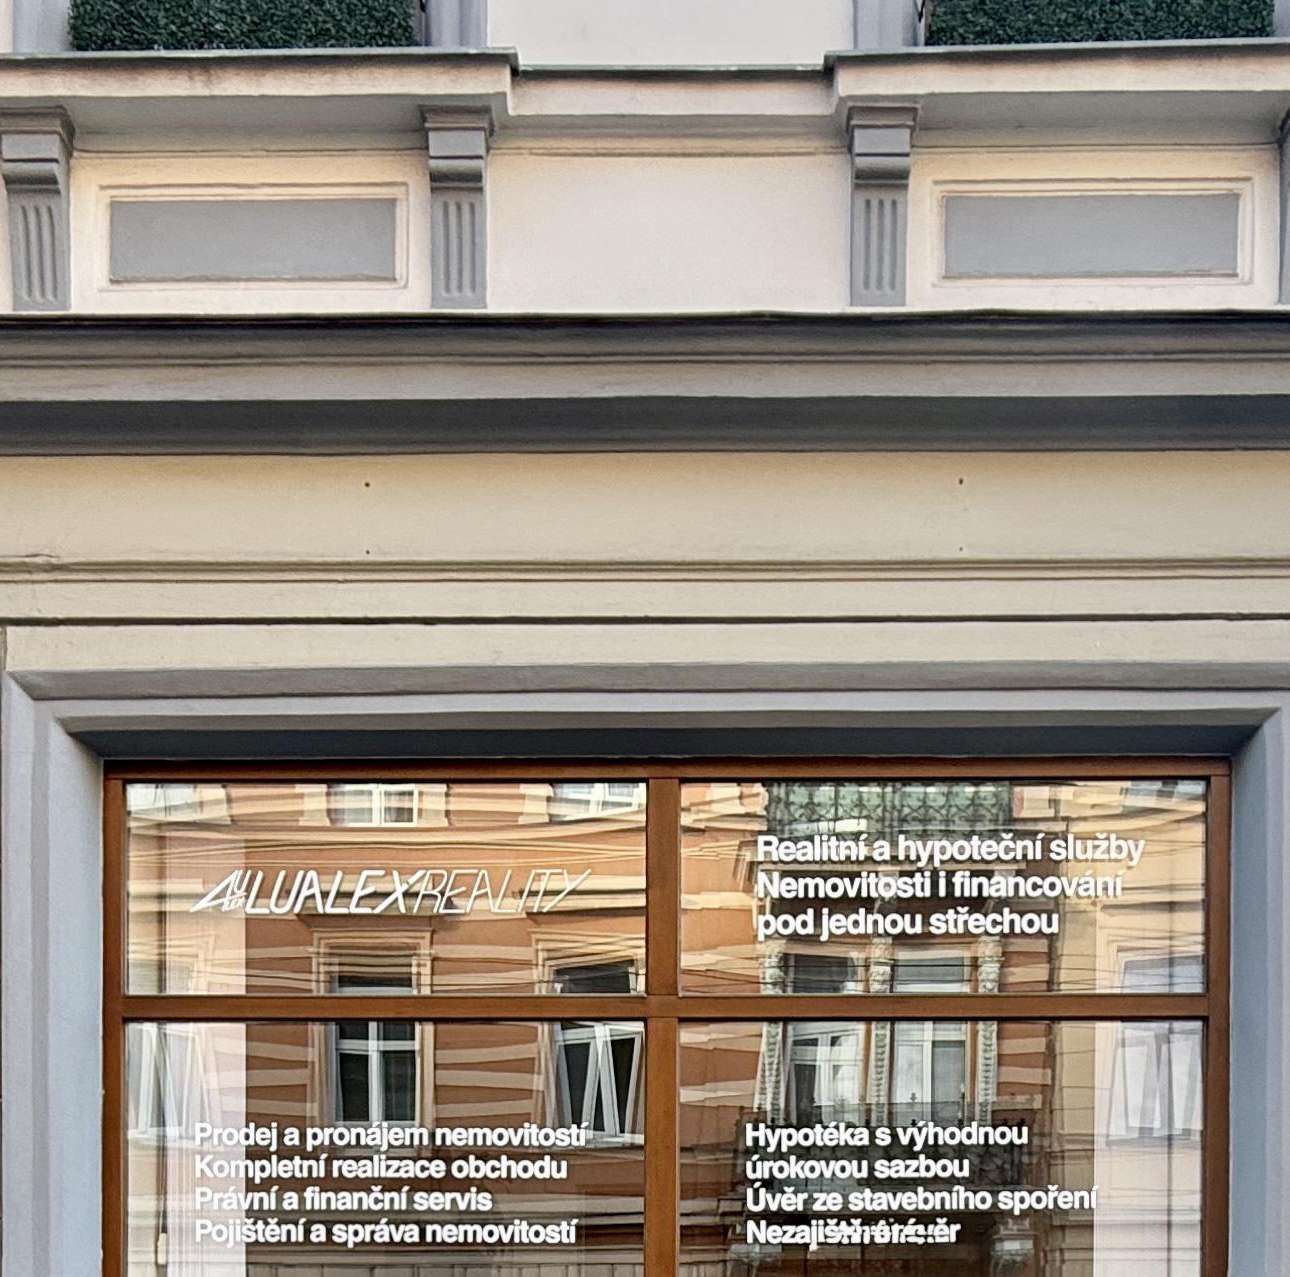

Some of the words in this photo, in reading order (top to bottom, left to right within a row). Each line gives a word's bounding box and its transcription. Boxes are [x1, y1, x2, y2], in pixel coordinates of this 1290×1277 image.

[757, 832, 866, 862] Realitní
[873, 840, 890, 862] a
[898, 832, 1042, 868] hypoteční
[1049, 833, 1145, 868] služby
[757, 872, 931, 898] Nemovitosti
[938, 872, 946, 897] i
[952, 870, 1123, 898] financování
[758, 909, 814, 941] pod
[820, 908, 922, 941] jednou
[929, 907, 1059, 935] střechou
[195, 1122, 277, 1152] Prodej
[283, 1128, 298, 1147] a
[306, 1121, 428, 1152] pronájem
[435, 1121, 588, 1147] nemovitostí
[745, 1122, 869, 1152] Hypotéka
[875, 1128, 891, 1146] s
[897, 1121, 1028, 1151] výhodnou
[195, 1155, 325, 1184] Kompletní
[332, 1155, 446, 1178] realizace
[451, 1155, 567, 1178] obchodu
[745, 1155, 868, 1179] úrokovou
[874, 1155, 969, 1178] sazbou
[195, 1186, 278, 1211] Právní
[283, 1192, 298, 1211] a
[304, 1186, 410, 1211] finanční
[413, 1187, 492, 1211] servis
[746, 1184, 808, 1212] Úvěr
[813, 1192, 843, 1211] ze
[848, 1185, 992, 1212] stavebního
[997, 1184, 1098, 1216] spoření
[195, 1219, 304, 1248] Pojištění
[310, 1225, 326, 1243] a
[332, 1219, 419, 1248] správa
[425, 1219, 577, 1244] nemovitostí
